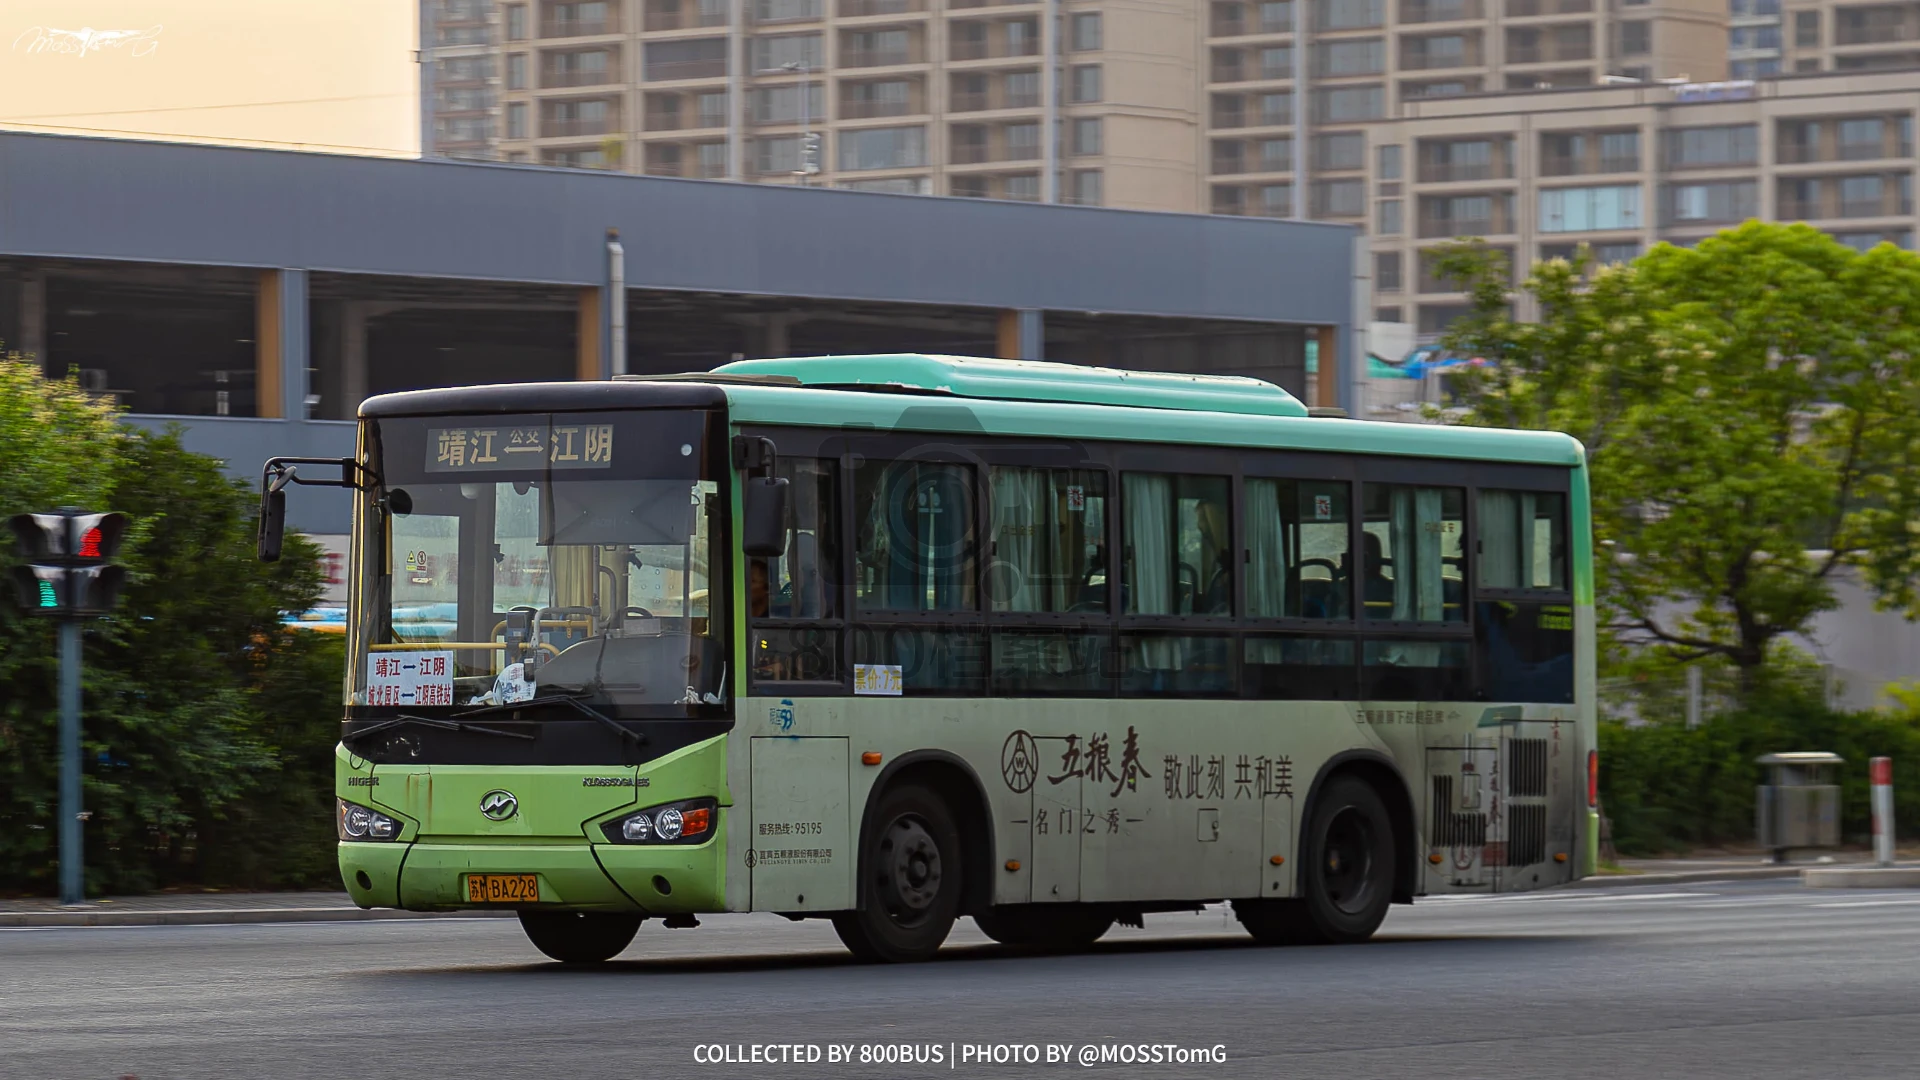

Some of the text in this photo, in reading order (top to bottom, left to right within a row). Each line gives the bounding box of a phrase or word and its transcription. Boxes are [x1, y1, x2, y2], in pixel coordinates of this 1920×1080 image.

[437, 425, 613, 466] 靖江 江阴
[375, 657, 445, 677] 靖江 江阴
[415, 683, 451, 706] 江阴高铁站
[348, 776, 380, 787] HIGER
[1163, 754, 1293, 799] 敬此刻 共和美
